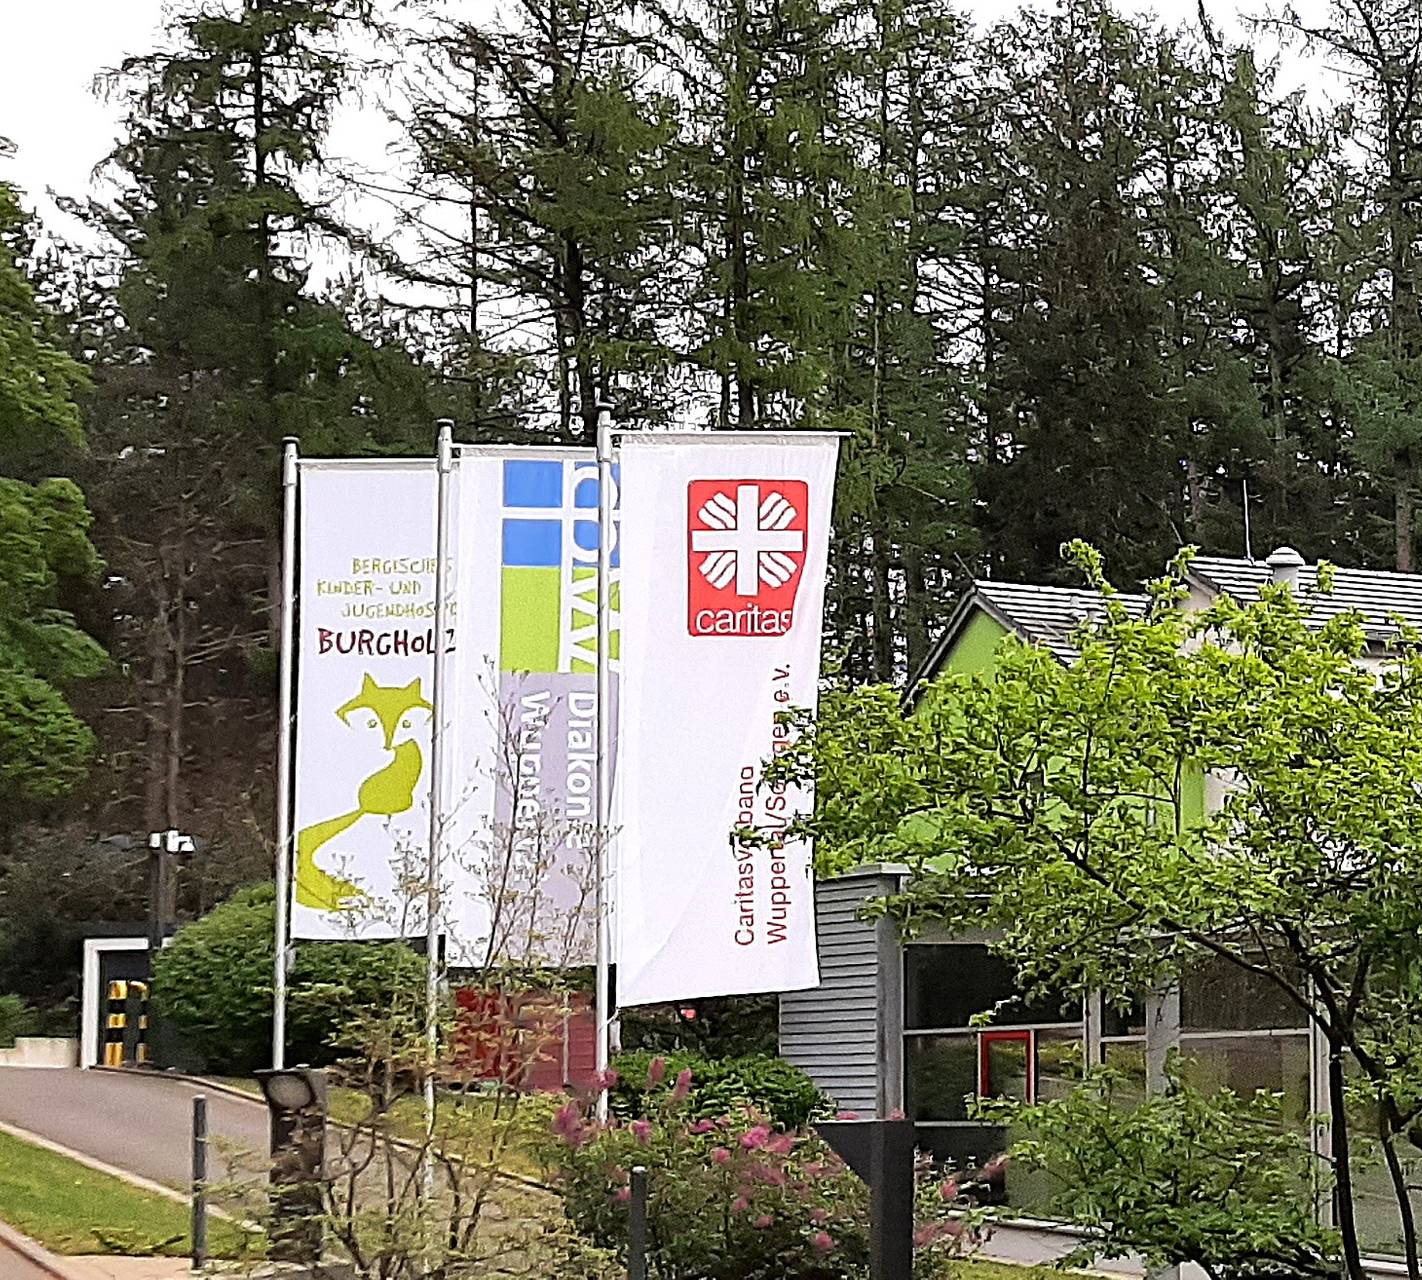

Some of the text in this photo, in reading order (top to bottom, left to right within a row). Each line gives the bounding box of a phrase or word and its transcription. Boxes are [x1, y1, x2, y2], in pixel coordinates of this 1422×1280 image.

[317, 579, 422, 597] KINDER- UND
[341, 601, 458, 620] JUGENDHOSI
[695, 602, 792, 634] caritas
[566, 691, 598, 849] Diakone
[734, 766, 755, 946] Caritasvband
[765, 710, 792, 945] Wuppertal/Sogen
